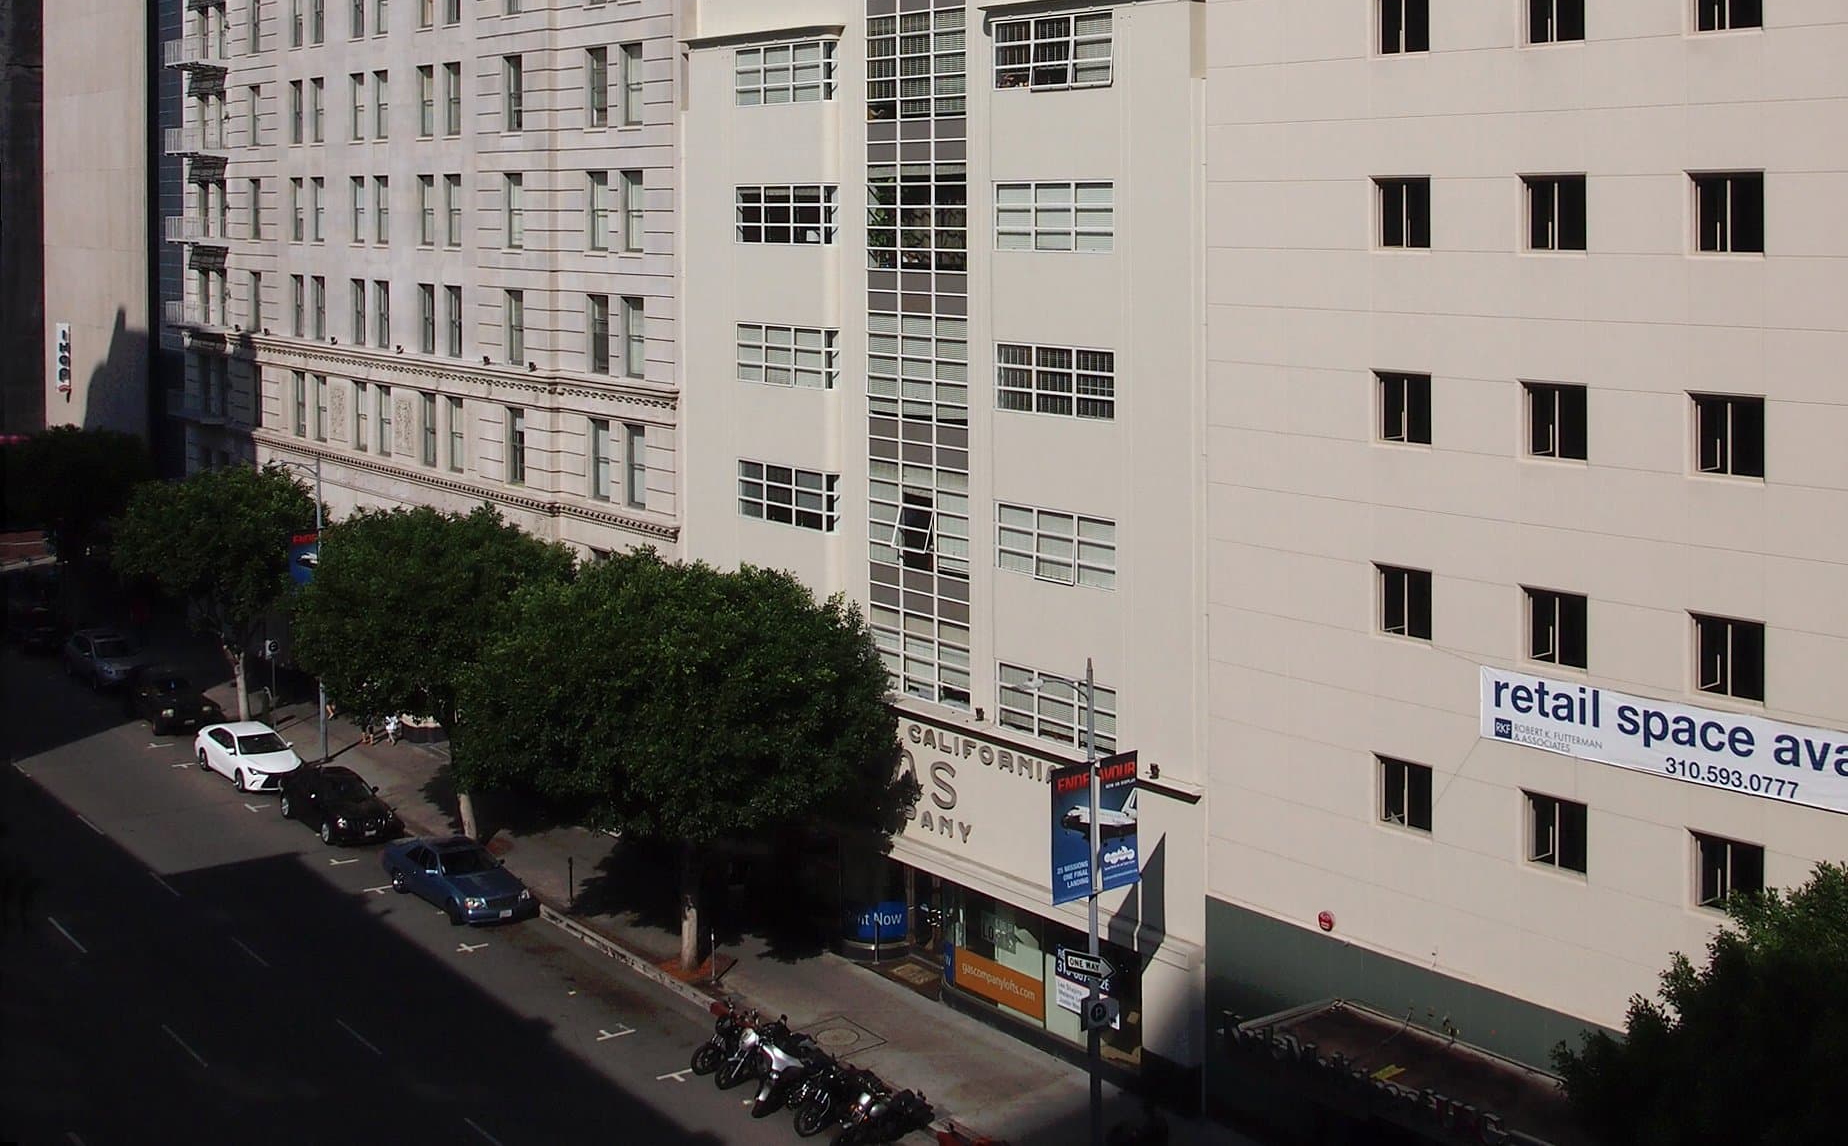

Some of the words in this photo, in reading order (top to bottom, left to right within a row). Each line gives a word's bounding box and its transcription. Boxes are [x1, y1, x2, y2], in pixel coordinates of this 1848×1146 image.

[1494, 680, 1600, 729] retail
[1617, 704, 1756, 758] space
[1495, 721, 1512, 736] RKF
[1513, 722, 1544, 736] ROBERT
[1553, 731, 1603, 750] FUTTERMAN
[1514, 733, 1520, 742] &
[1521, 736, 1571, 753] ASSOCIATES
[1665, 757, 1799, 799] 310.593.0777
[1066, 876, 1089, 889] LANDING
[874, 912, 902, 927] Now
[1069, 956, 1084, 968] ONE
[1085, 961, 1100, 972] WAY
[961, 962, 1035, 1003] gascompanylofts.com
